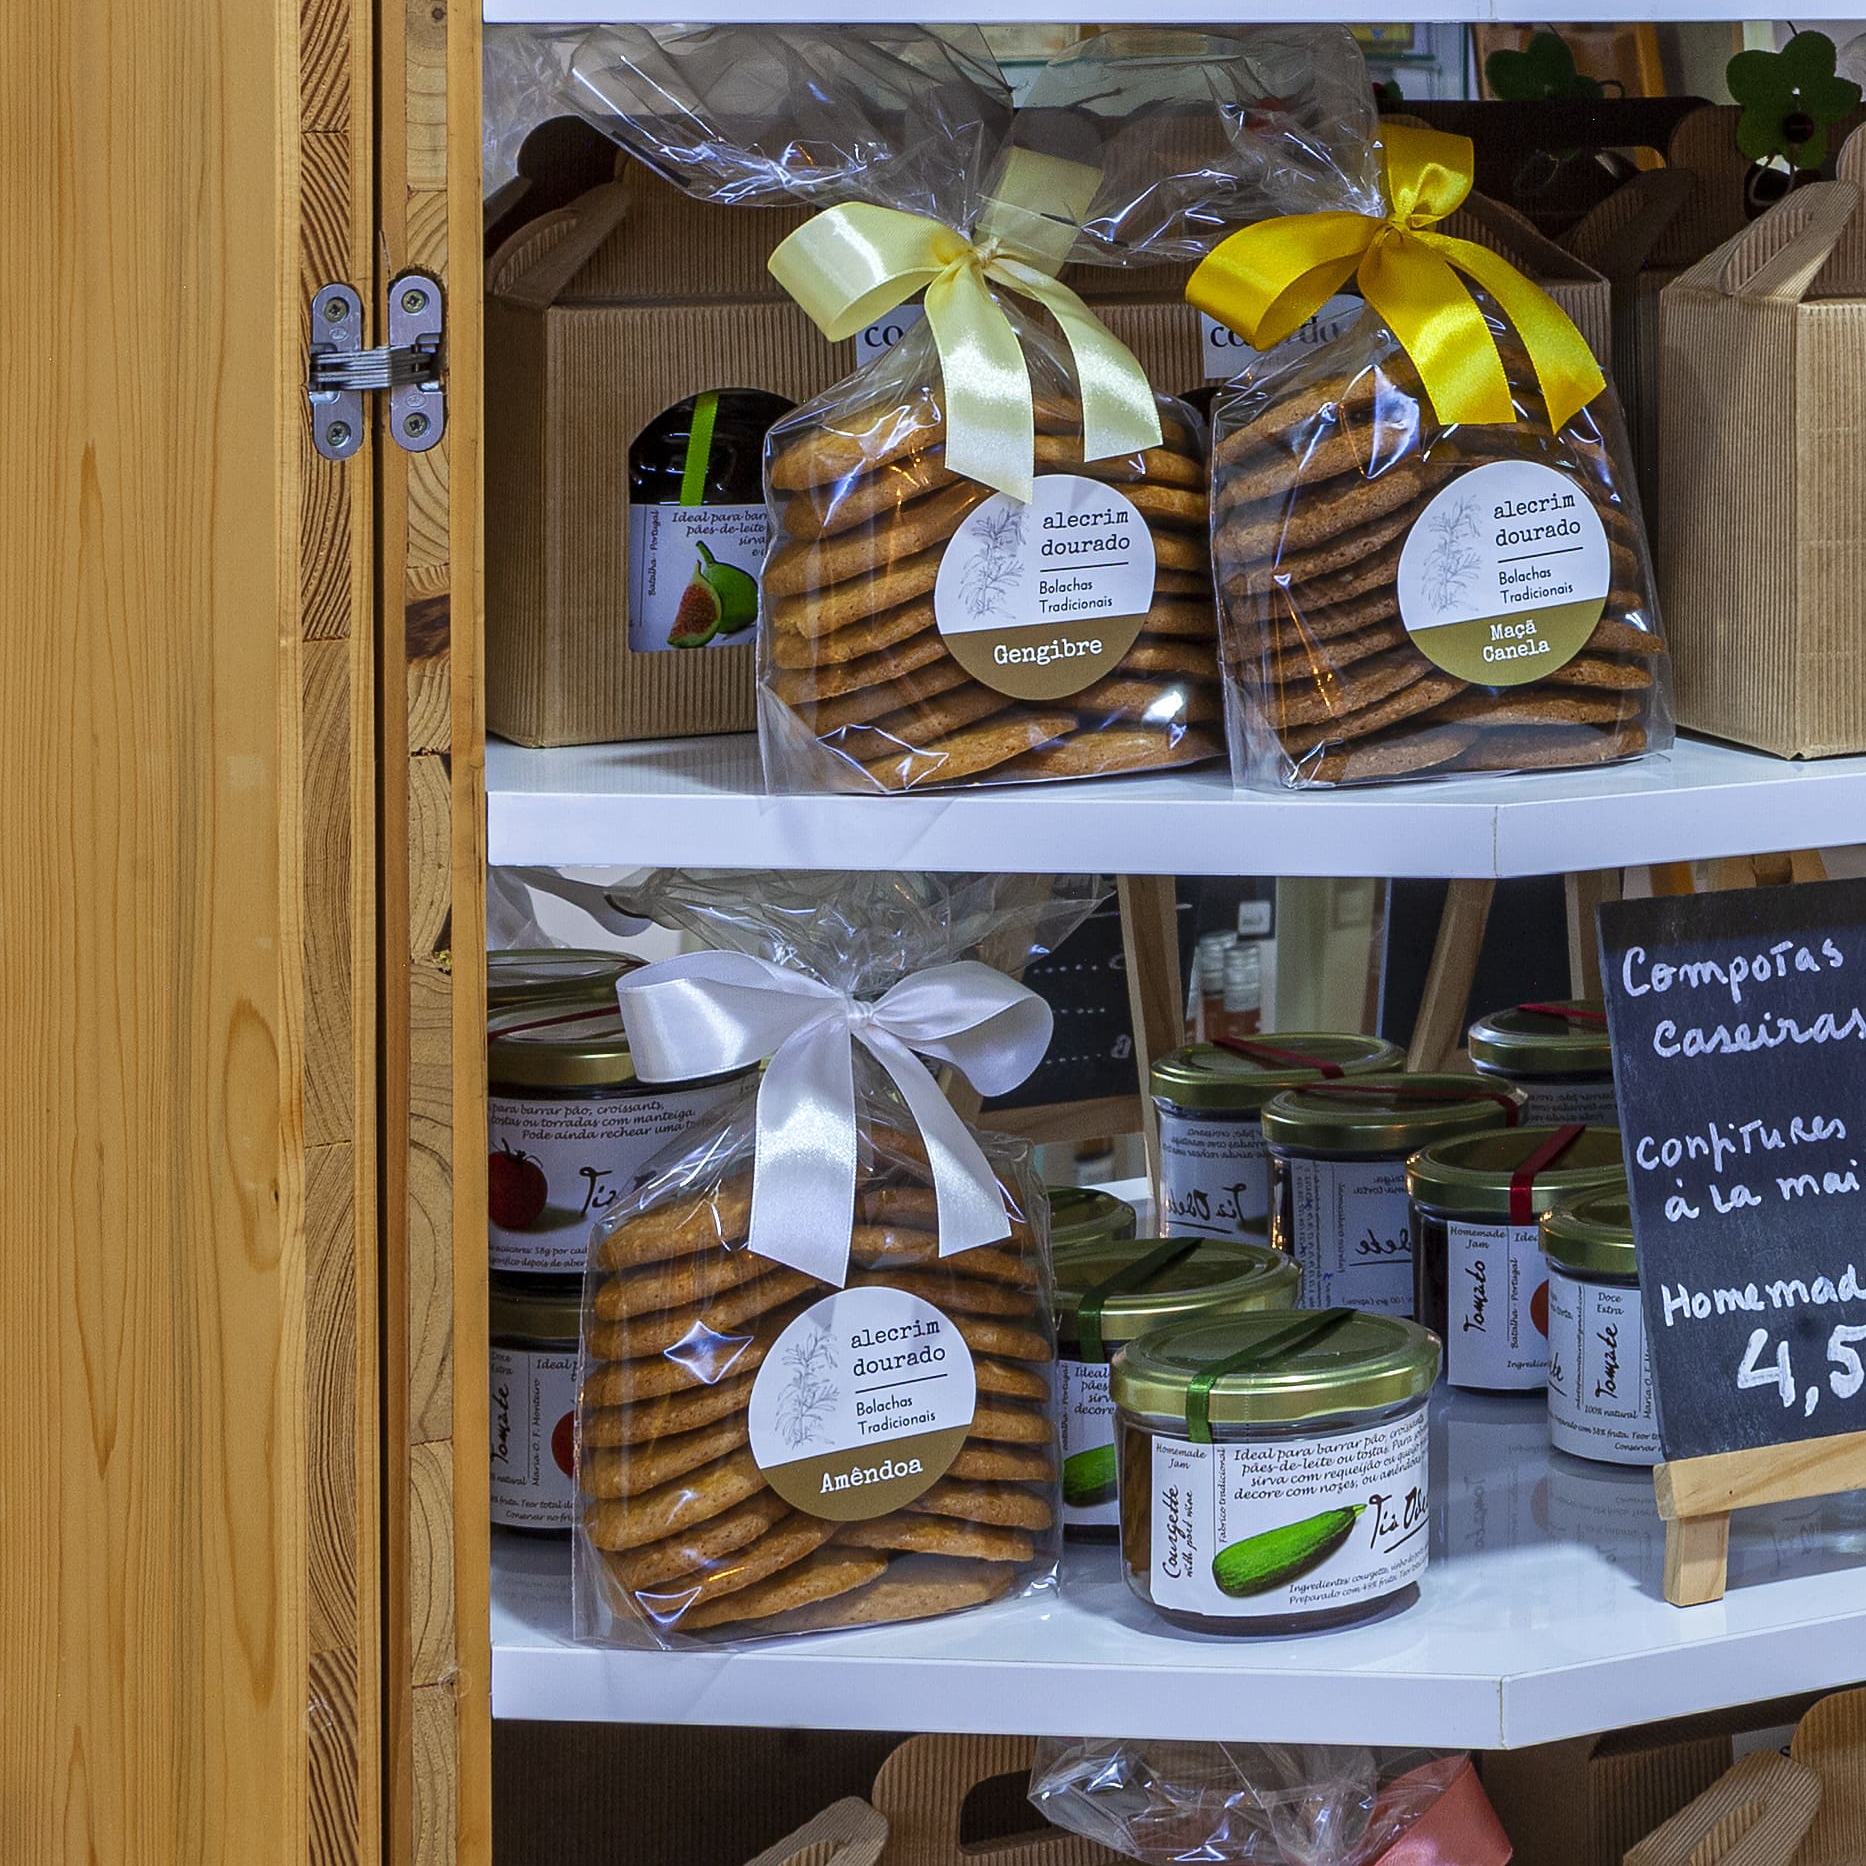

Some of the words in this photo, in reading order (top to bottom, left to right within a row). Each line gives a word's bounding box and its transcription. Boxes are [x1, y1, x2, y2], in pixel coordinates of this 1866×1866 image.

[1493, 492, 1576, 519] alecrim
[1043, 508, 1129, 530] alecrim
[1496, 518, 1581, 547] dourado
[1041, 534, 1131, 557] dourado
[1040, 577, 1093, 595] Bolachas
[1499, 566, 1552, 585] Bolachas
[1500, 582, 1573, 604] Tradicionais
[1040, 596, 1113, 614] Tradicionais
[1489, 619, 1537, 641] Maçã
[994, 638, 1103, 666] Gengibre
[1482, 638, 1551, 662] Canela
[1450, 1226, 1505, 1238] Homemade
[1465, 1239, 1490, 1249] Jam
[1463, 1260, 1486, 1333] Tomato
[1598, 1292, 1623, 1303] Doce
[850, 1319, 941, 1350] alecrim
[853, 1345, 946, 1377] dourado
[1595, 1323, 1619, 1399] Tomate
[855, 1395, 913, 1417] Bolachas
[1604, 1410, 1638, 1419] natural
[858, 1410, 936, 1436] Tradicionais
[1156, 1443, 1207, 1460] Homemade
[1234, 1446, 1275, 1461] Ideal
[1277, 1443, 1314, 1462] para
[1316, 1439, 1363, 1455] barrar
[1169, 1458, 1191, 1470] Jam
[819, 1457, 923, 1494] Amêndoa
[1368, 1493, 1399, 1550] Tia
